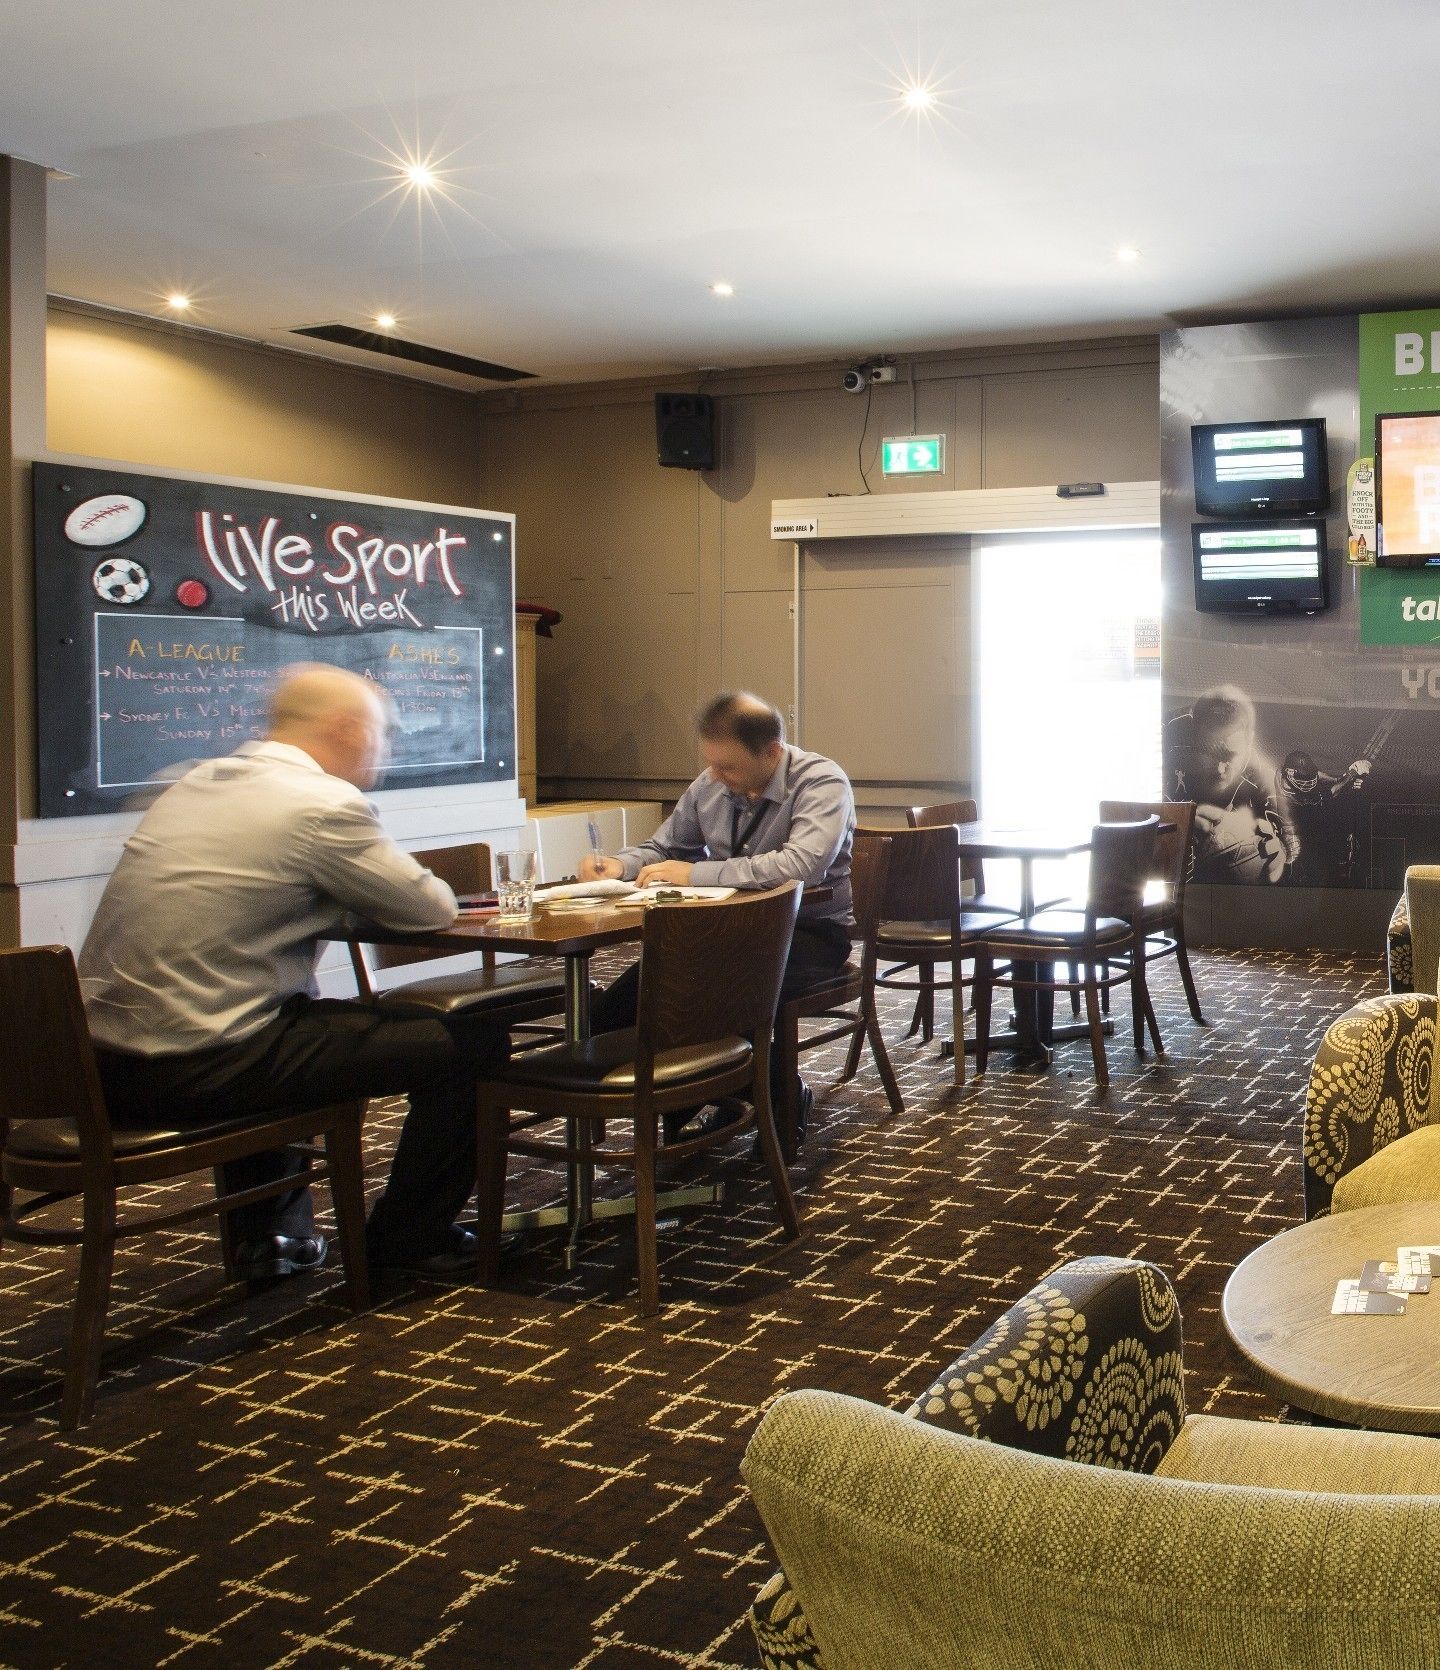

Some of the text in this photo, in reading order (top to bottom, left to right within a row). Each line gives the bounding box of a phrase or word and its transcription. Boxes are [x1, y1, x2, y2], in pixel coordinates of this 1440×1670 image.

[1352, 490, 1374, 498] KNOCK
[773, 525, 795, 533] SMOKING
[322, 524, 468, 597] Sport
[336, 584, 423, 628] Week
[128, 638, 246, 662] A-LEAGUE
[388, 643, 460, 665] ASHES
[115, 665, 192, 681] NEWCASTLE
[153, 684, 212, 695] SATURDAY
[416, 684, 447, 698] FRIDAY
[119, 708, 169, 723] SYDNEY
[157, 726, 212, 741] SUNDAY
